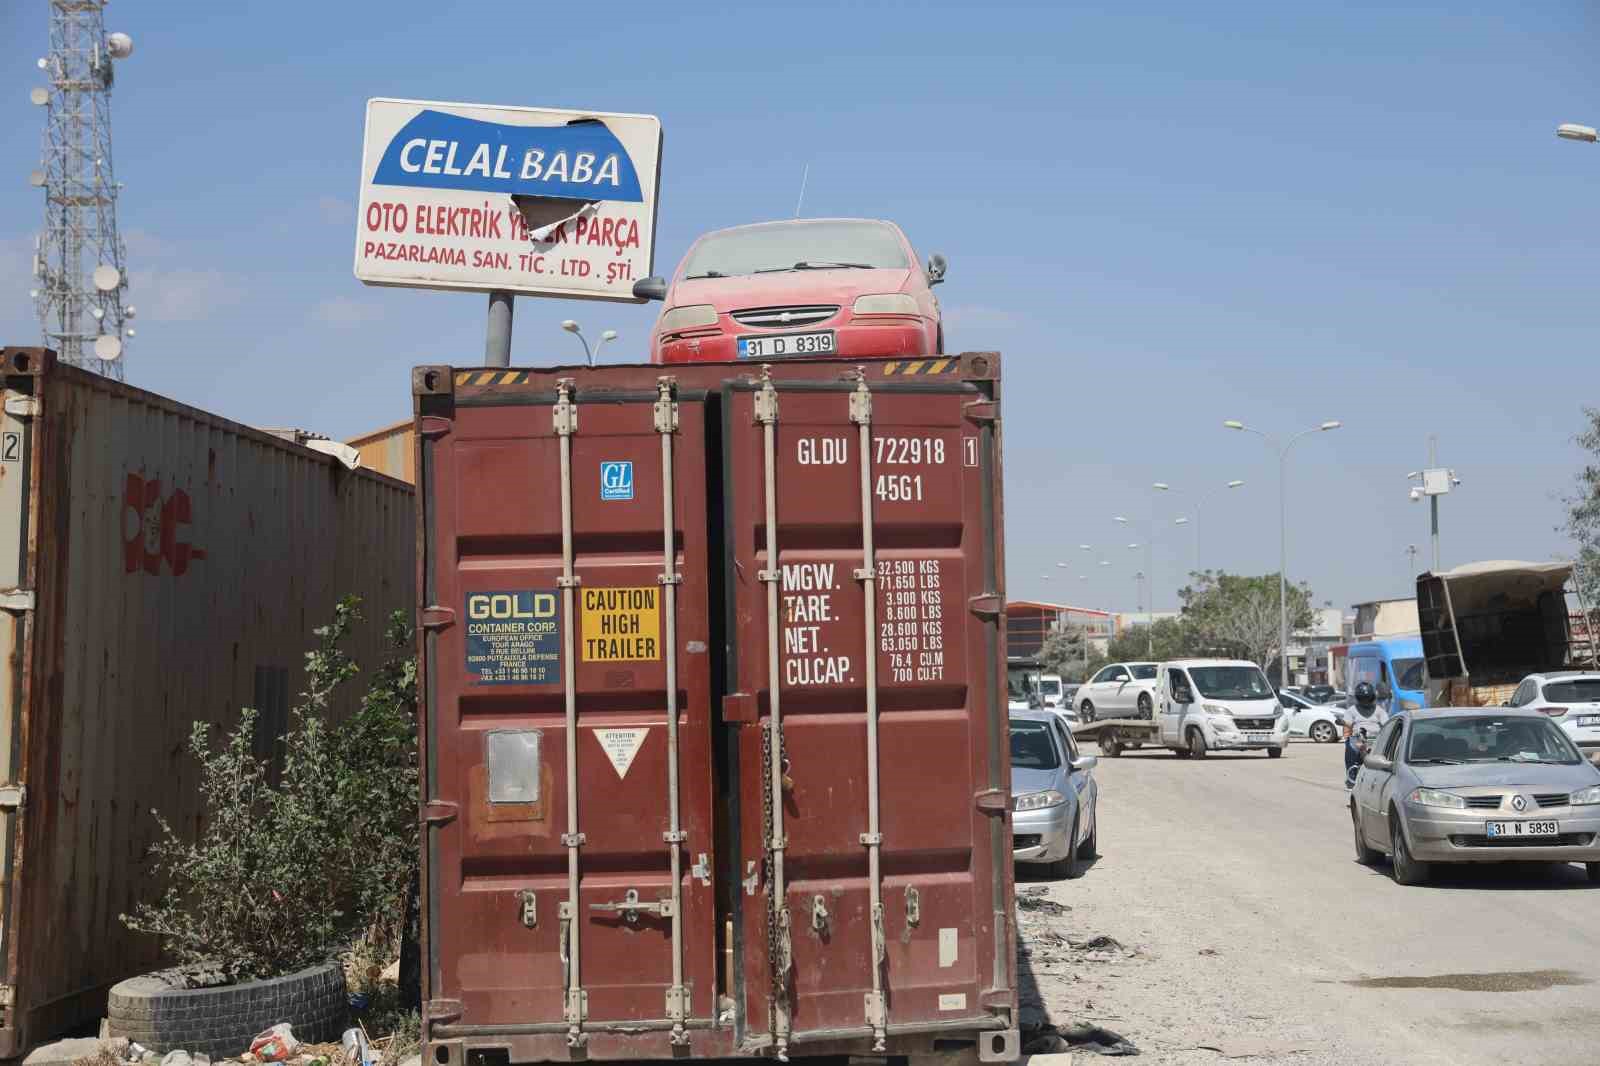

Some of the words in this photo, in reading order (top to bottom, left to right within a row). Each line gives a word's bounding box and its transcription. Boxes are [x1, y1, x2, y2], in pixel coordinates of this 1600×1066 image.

[400, 138, 511, 179] CELAL
[520, 147, 620, 186] BABA
[367, 202, 407, 233] OTO
[416, 201, 501, 241] ELEKTRİK
[575, 216, 639, 256] PARÇA
[364, 242, 466, 267] PAZARLAMA
[473, 250, 512, 270] SAN.
[607, 258, 636, 285] ŞTİ.
[748, 340, 763, 356] 31
[774, 339, 785, 354] D
[796, 335, 831, 352] 8319
[5, 434, 18, 459] 2
[798, 438, 847, 465] GLDU
[874, 437, 945, 465] 722918
[604, 463, 631, 488] GL
[876, 475, 922, 501] 45G1
[783, 563, 841, 591] MGW.
[920, 560, 940, 574] KGS
[920, 575, 940, 589] LBS
[469, 594, 556, 619] GOLD
[586, 589, 654, 610] CAUTION
[921, 590, 941, 605] KGS
[784, 595, 840, 623] TARE.
[922, 605, 942, 619] LBS
[468, 623, 525, 633] CONTAINER
[527, 622, 557, 632] CORP.
[601, 614, 640, 634] HIGH
[922, 621, 942, 635] KGS
[586, 638, 655, 660] TRAILER
[785, 626, 829, 654] NET.
[923, 636, 942, 650] LBS
[920, 651, 944, 666] CU.M
[786, 656, 854, 686] CU.CAP.
[917, 666, 944, 681] CU.FT
[1495, 823, 1506, 834] 31
[1514, 823, 1522, 834] N
[1529, 822, 1555, 834] 5839
